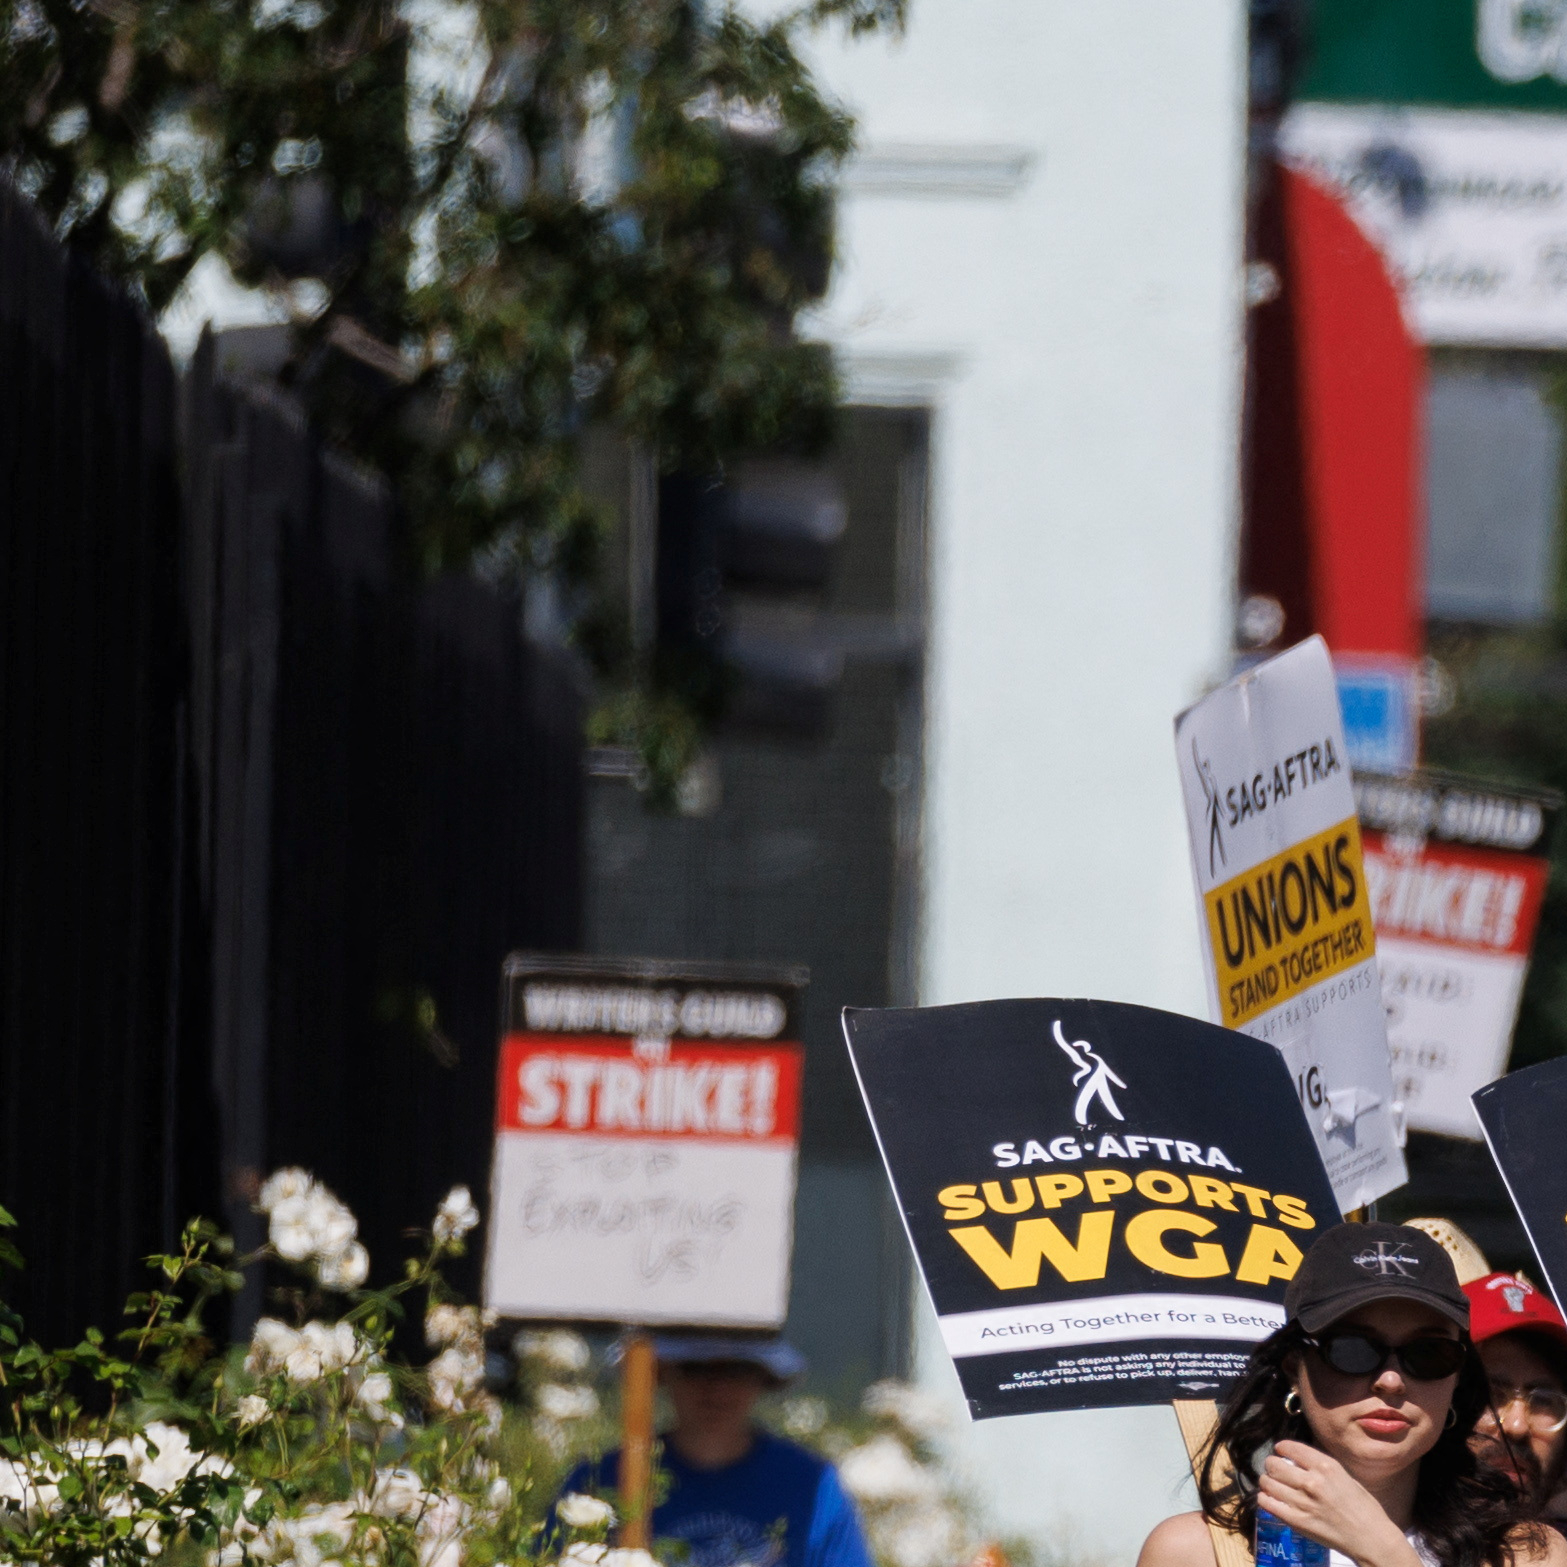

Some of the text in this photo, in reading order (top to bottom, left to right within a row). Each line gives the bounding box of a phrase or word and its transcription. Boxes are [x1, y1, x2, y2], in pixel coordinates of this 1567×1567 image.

[1216, 831, 1357, 968] UNIONS
[1228, 920, 1365, 1020] STAND TOGETHER
[1304, 966, 1371, 1018] SUPPORTS
[518, 1055, 777, 1134] STRIKE!
[937, 1169, 1316, 1230] SUPPORTS
[947, 1208, 1304, 1290] WGA
[980, 1309, 1286, 1340] Acting Together for a Bette
[998, 1378, 1048, 1390] services,
[1079, 1373, 1114, 1382] refuse
[1130, 1370, 1155, 1379] pick
[1077, 1355, 1120, 1366] dispute
[1121, 1353, 1148, 1362] with
[1172, 1352, 1203, 1360] other
[1204, 1353, 1251, 1361] employe
[1093, 1364, 1114, 1372] not
[1115, 1361, 1154, 1371] asking
[1155, 1361, 1176, 1369] any
[1233, 1361, 1246, 1369] to
